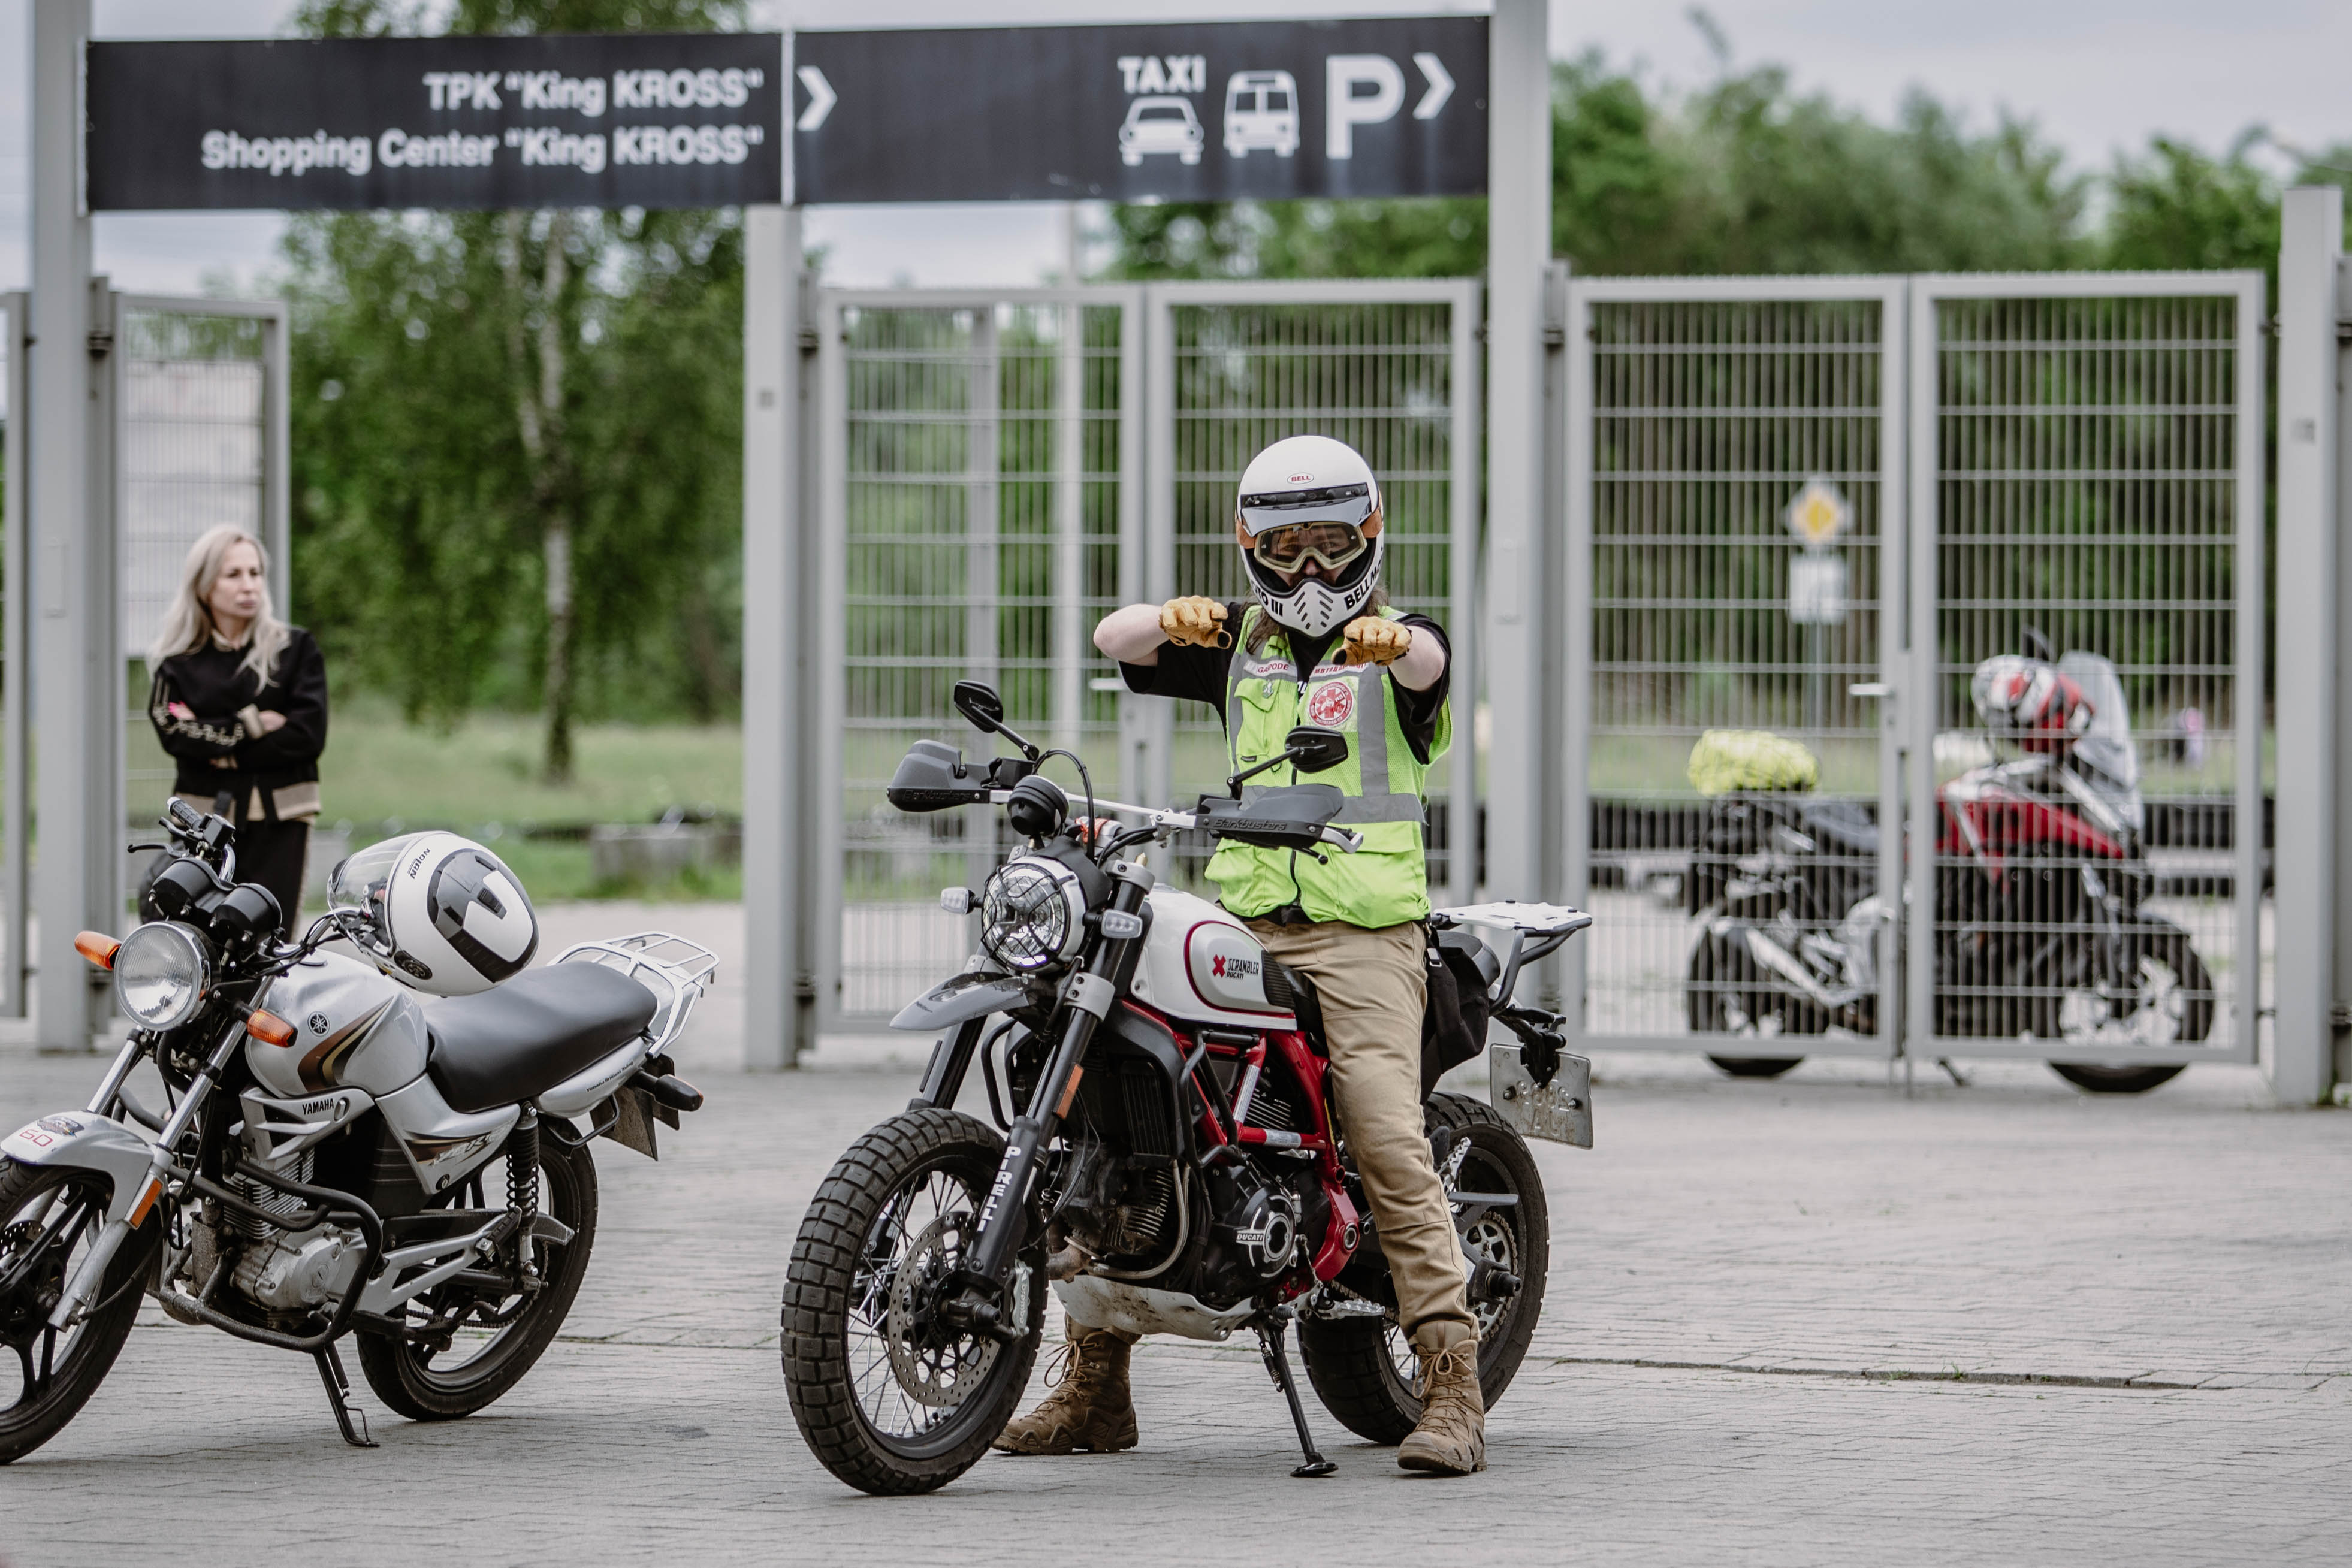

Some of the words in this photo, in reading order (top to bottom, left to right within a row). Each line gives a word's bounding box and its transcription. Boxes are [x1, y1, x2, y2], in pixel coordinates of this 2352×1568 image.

[1117, 55, 1206, 93] TAXI
[422, 71, 503, 110] TPK
[505, 70, 606, 117] "King
[612, 68, 765, 108] KROSS"
[1326, 54, 1406, 159] P
[201, 129, 373, 176] Shopping
[378, 127, 499, 167] Center
[504, 126, 607, 174] "King
[612, 124, 765, 165] KROSS"
[1271, 598, 1284, 617] III
[1344, 579, 1370, 610] BELL
[1214, 818, 1287, 831] Barkbusters
[408, 848, 430, 879] NOLAN
[1228, 959, 1259, 975] SCRAMBLER
[302, 1098, 334, 1115] YAMAHA
[20, 1129, 53, 1147] 60
[977, 1146, 1021, 1232] PIRELLI
